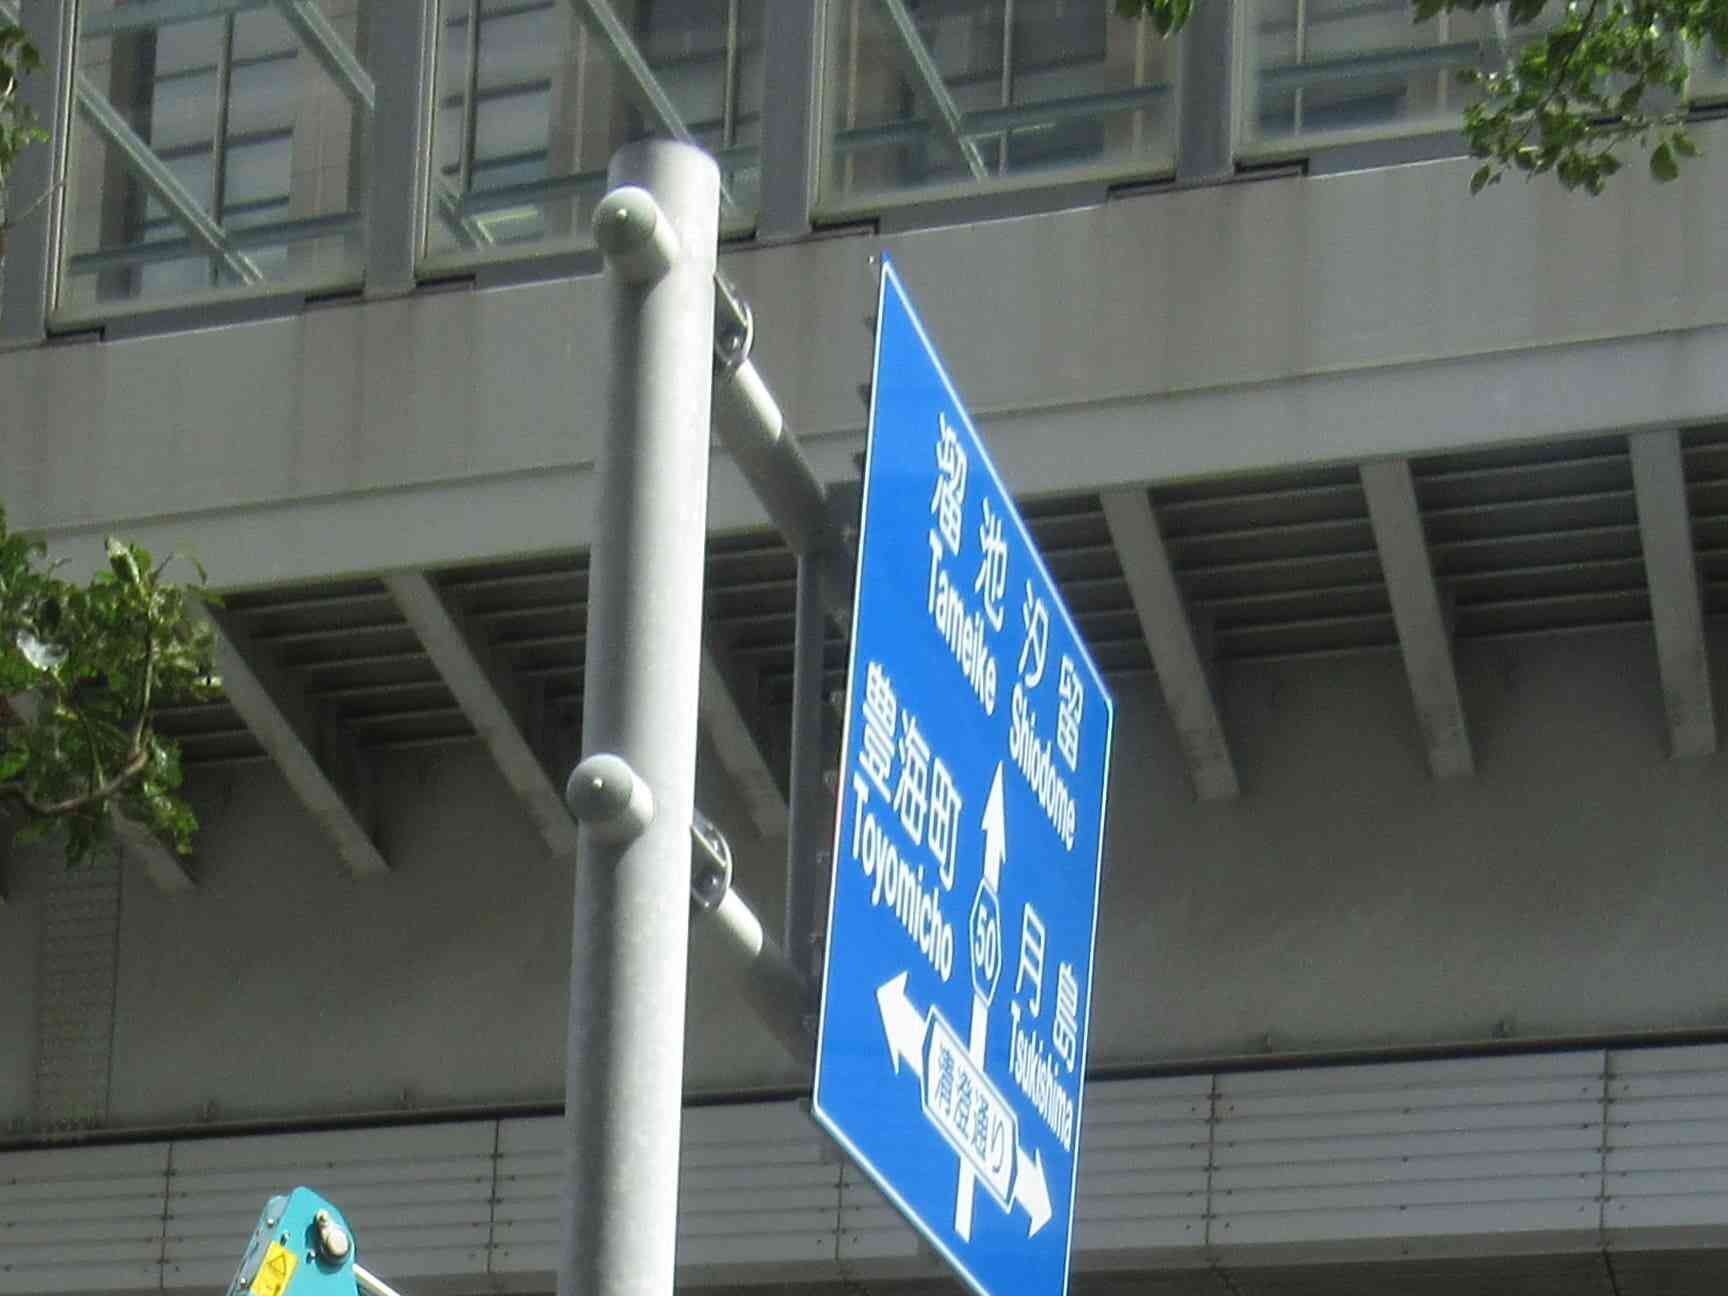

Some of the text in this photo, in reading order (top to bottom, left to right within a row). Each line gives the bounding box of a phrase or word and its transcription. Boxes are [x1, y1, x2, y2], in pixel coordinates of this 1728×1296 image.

[931, 412, 1007, 632] 溜池
[928, 529, 997, 716] Tameike
[1019, 579, 1083, 771] 汐留
[859, 661, 962, 890] 豊海町
[1010, 683, 1076, 851] Shiodome
[853, 770, 952, 981] Toyomicho
[975, 910, 996, 980] 50
[1009, 1000, 1073, 1152] Tsukishima
[1016, 903, 1078, 1073] 月島
[935, 1041, 1005, 1173] 清澄通り
